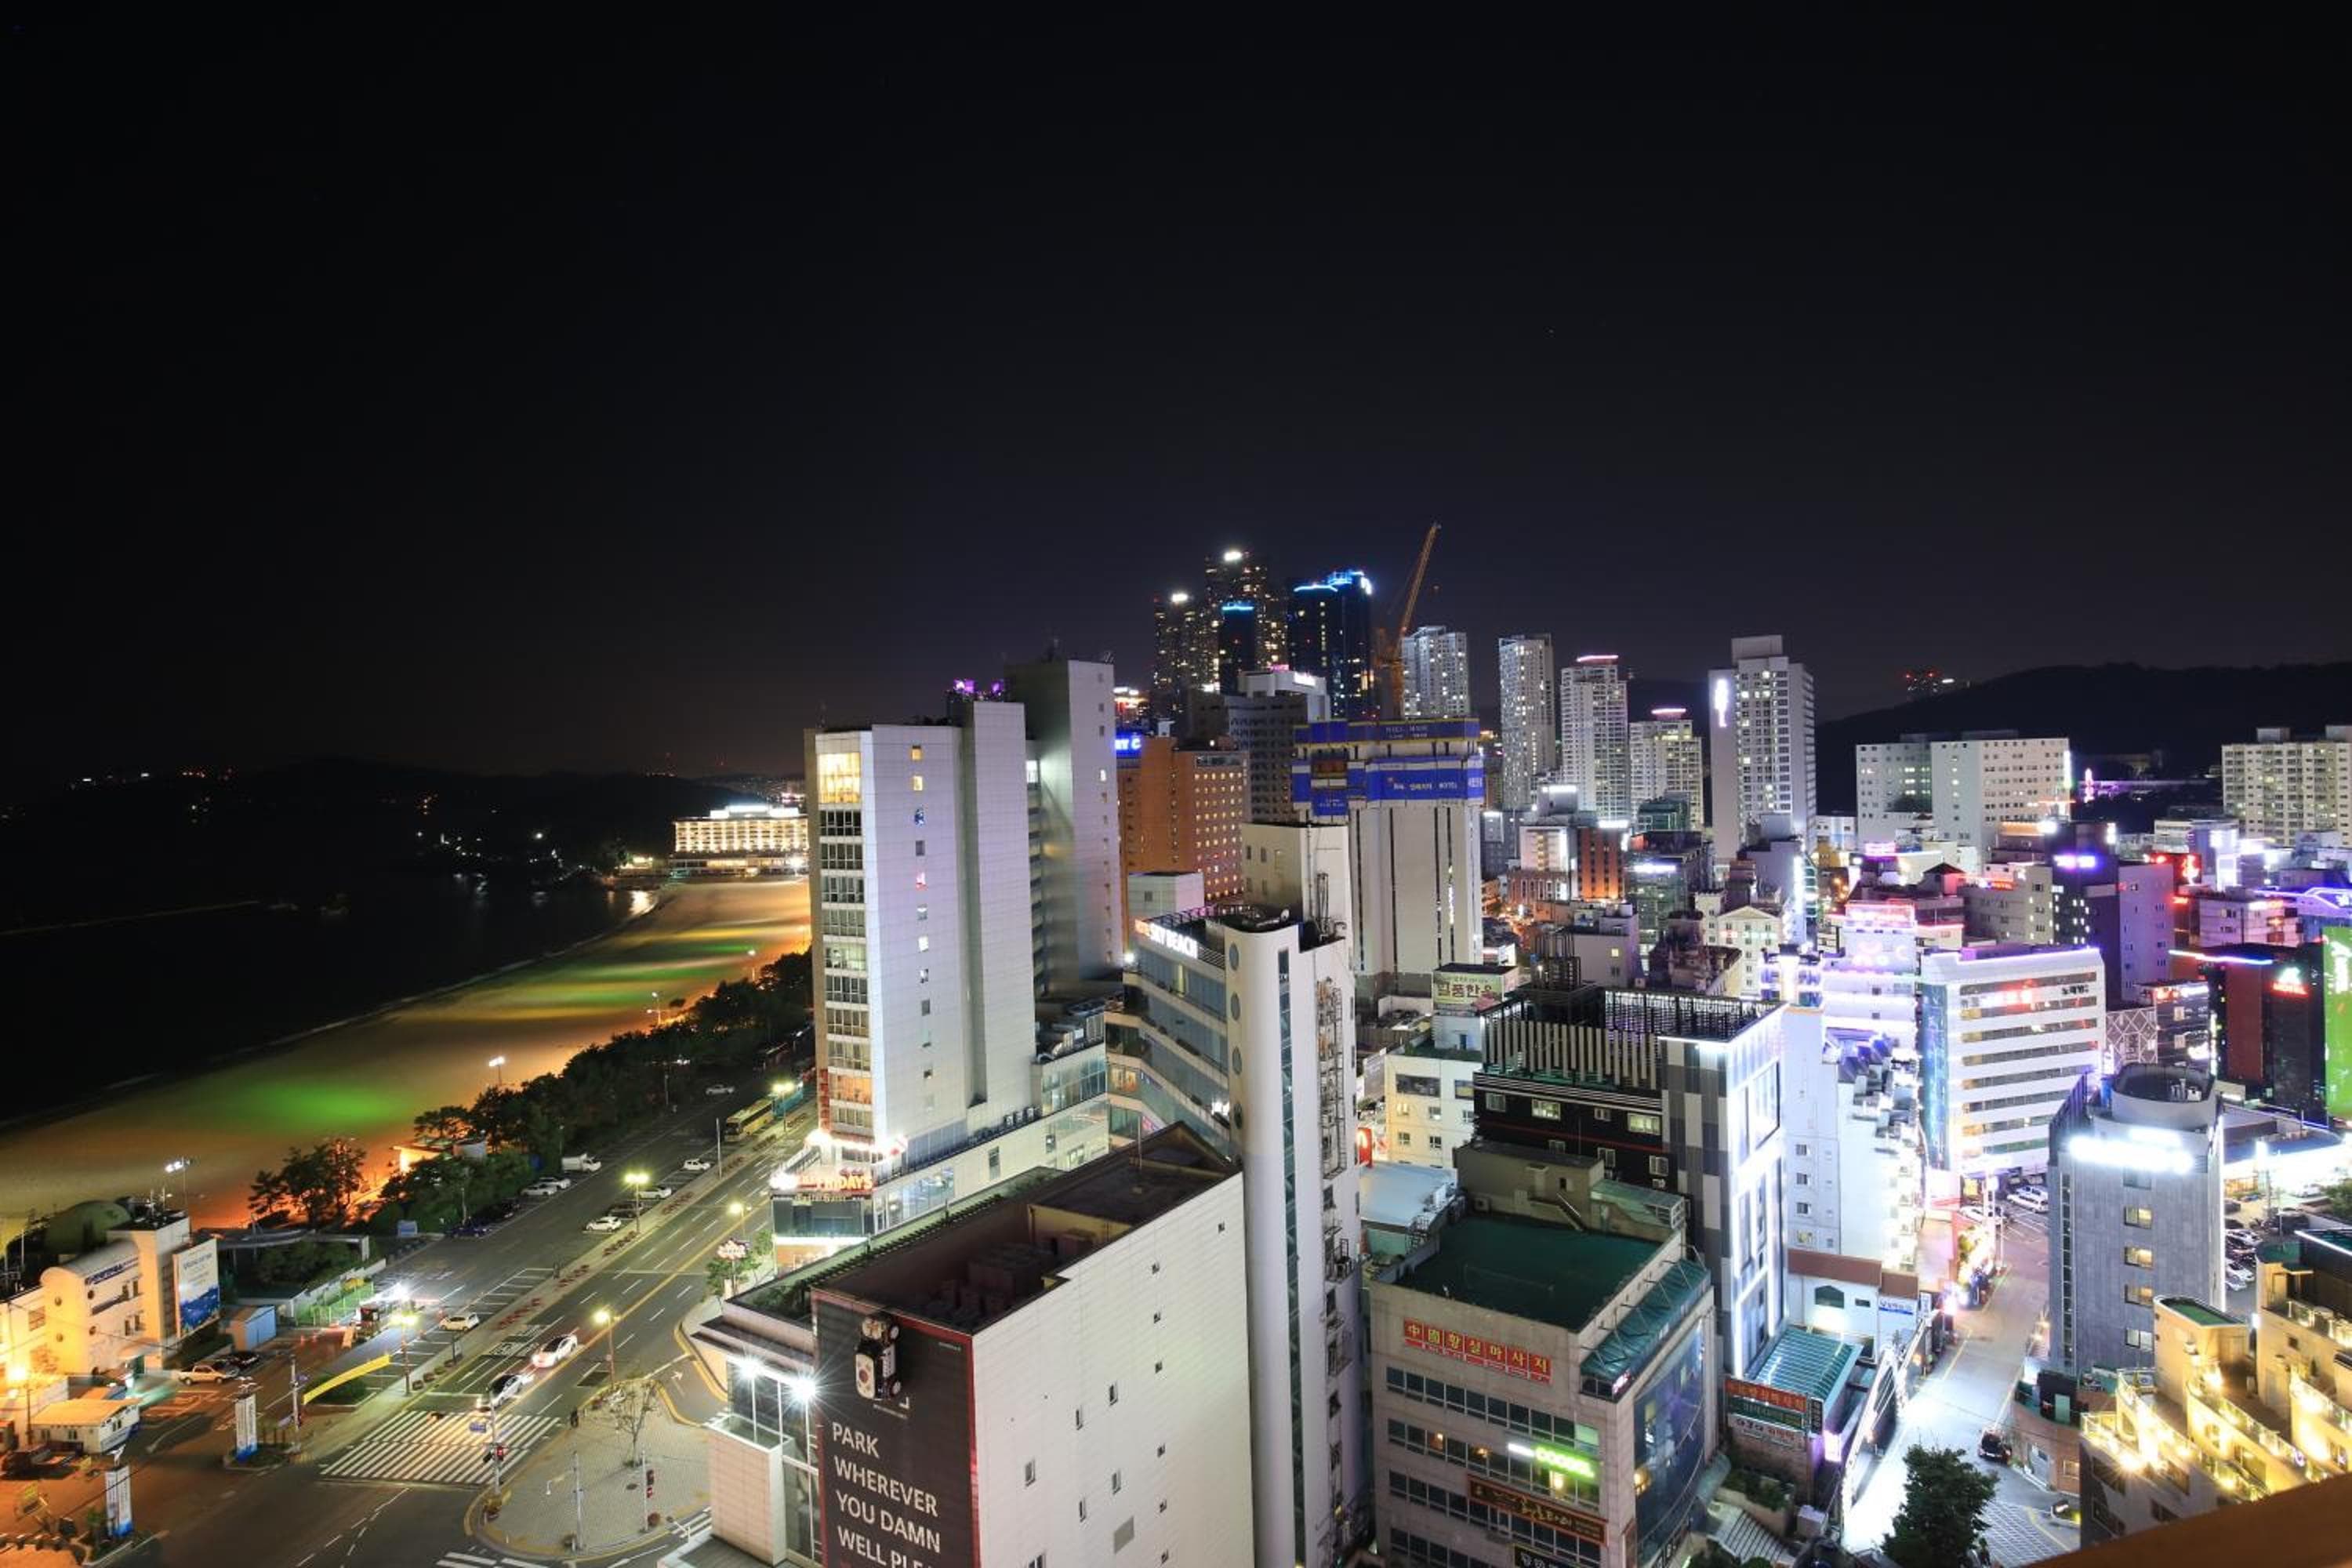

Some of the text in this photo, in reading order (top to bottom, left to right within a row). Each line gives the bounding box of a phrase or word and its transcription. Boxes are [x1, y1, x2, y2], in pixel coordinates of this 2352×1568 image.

[832, 1421, 880, 1458] PARK
[833, 1455, 939, 1518] WHEREVER
[836, 1489, 941, 1554] YOU DAMN
[837, 1525, 887, 1566] WELL
